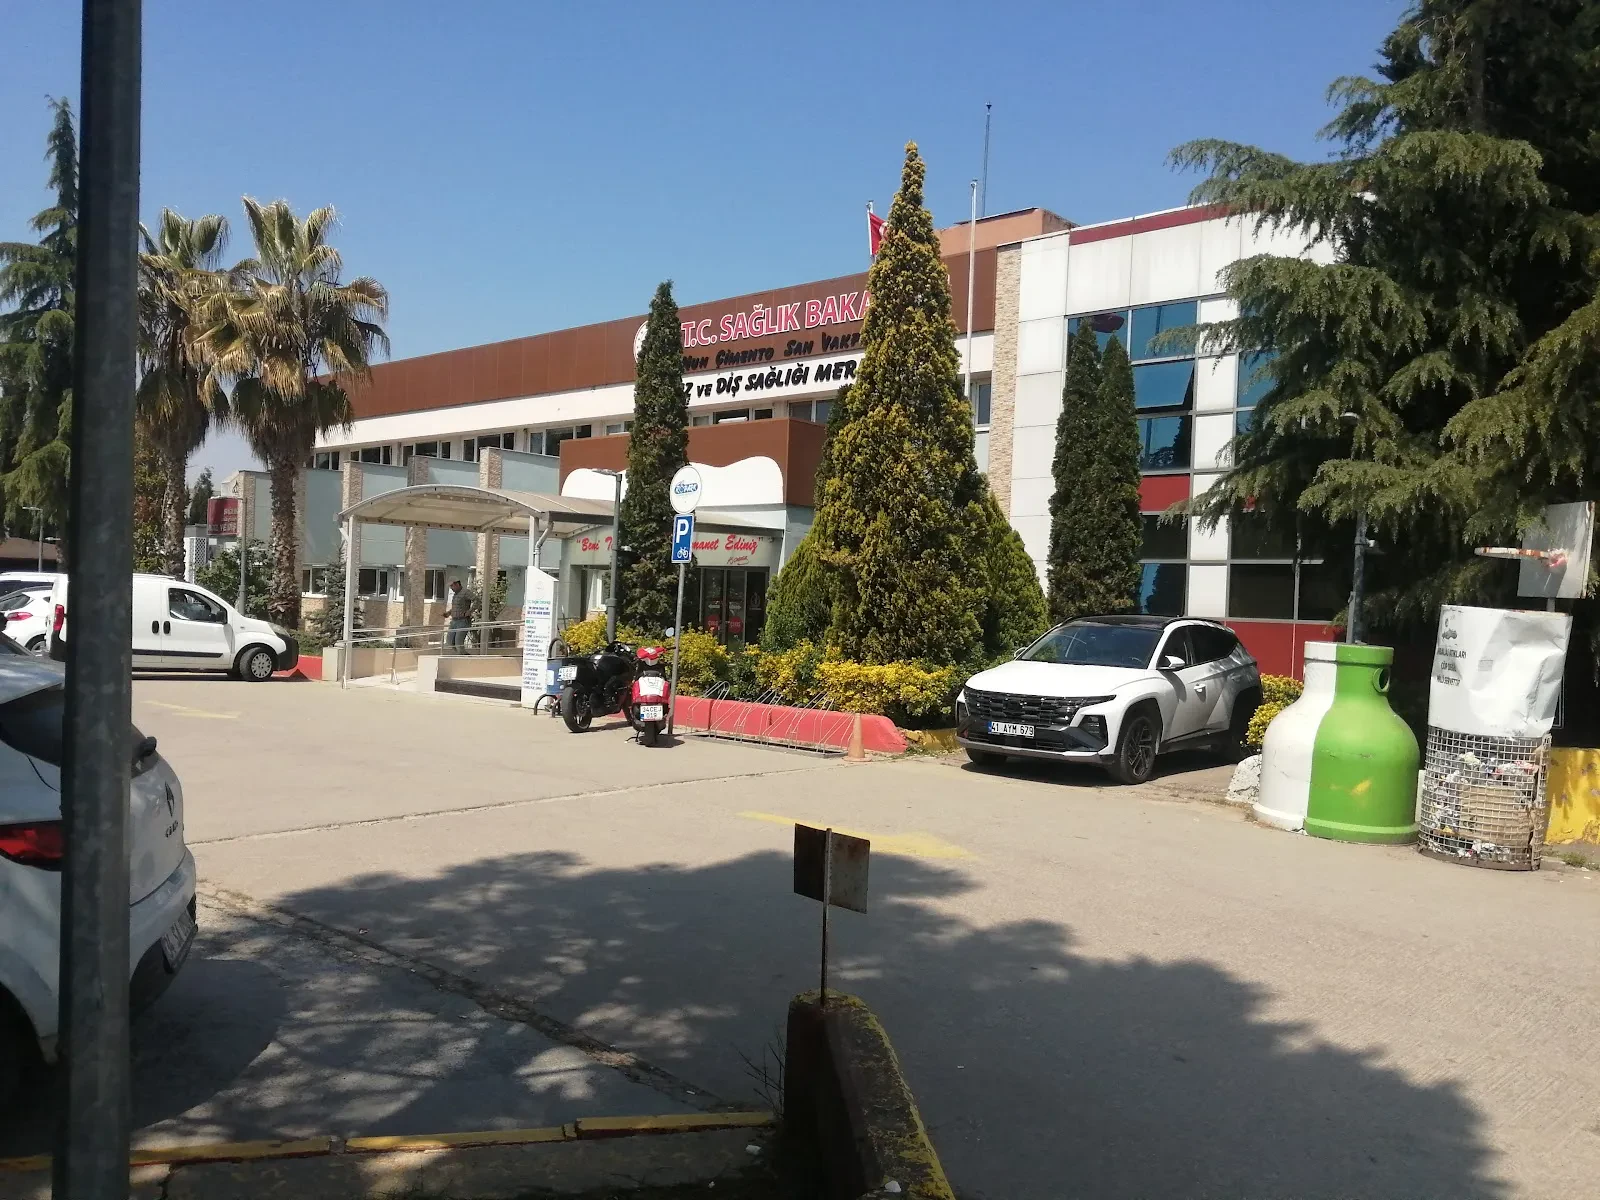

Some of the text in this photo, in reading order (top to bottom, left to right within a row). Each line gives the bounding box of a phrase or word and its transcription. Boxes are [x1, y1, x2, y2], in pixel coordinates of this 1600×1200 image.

[681, 319, 717, 348] T.C.
[720, 302, 801, 342] SAĞLIK
[697, 384, 713, 398] VE
[716, 372, 743, 397] DİŞ
[745, 362, 810, 391] SAĞLIĞI
[676, 519, 689, 543] P
[991, 722, 1034, 735] 41 AYM 679
